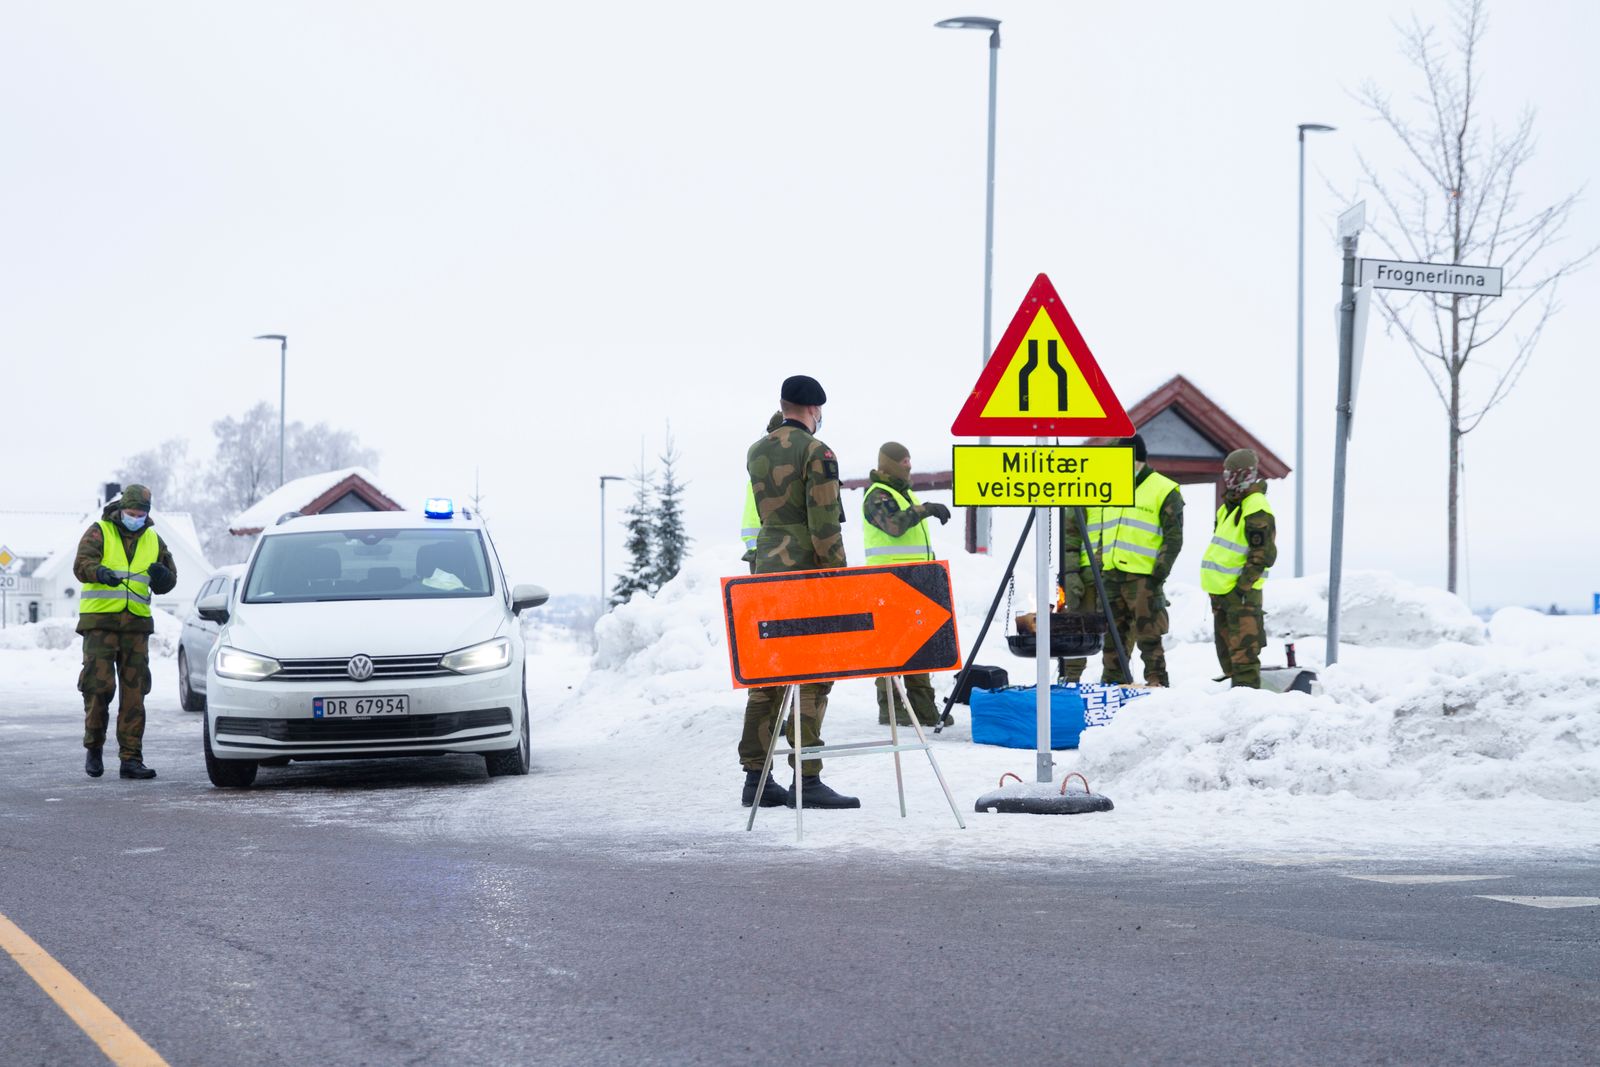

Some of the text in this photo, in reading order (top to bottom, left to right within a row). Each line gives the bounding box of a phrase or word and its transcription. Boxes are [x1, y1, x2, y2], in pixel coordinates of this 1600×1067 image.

[1377, 264, 1486, 288] Frognerlinna
[1002, 451, 1089, 474] Militær
[977, 477, 1113, 504] veisperring
[326, 698, 405, 716] DR 67954
